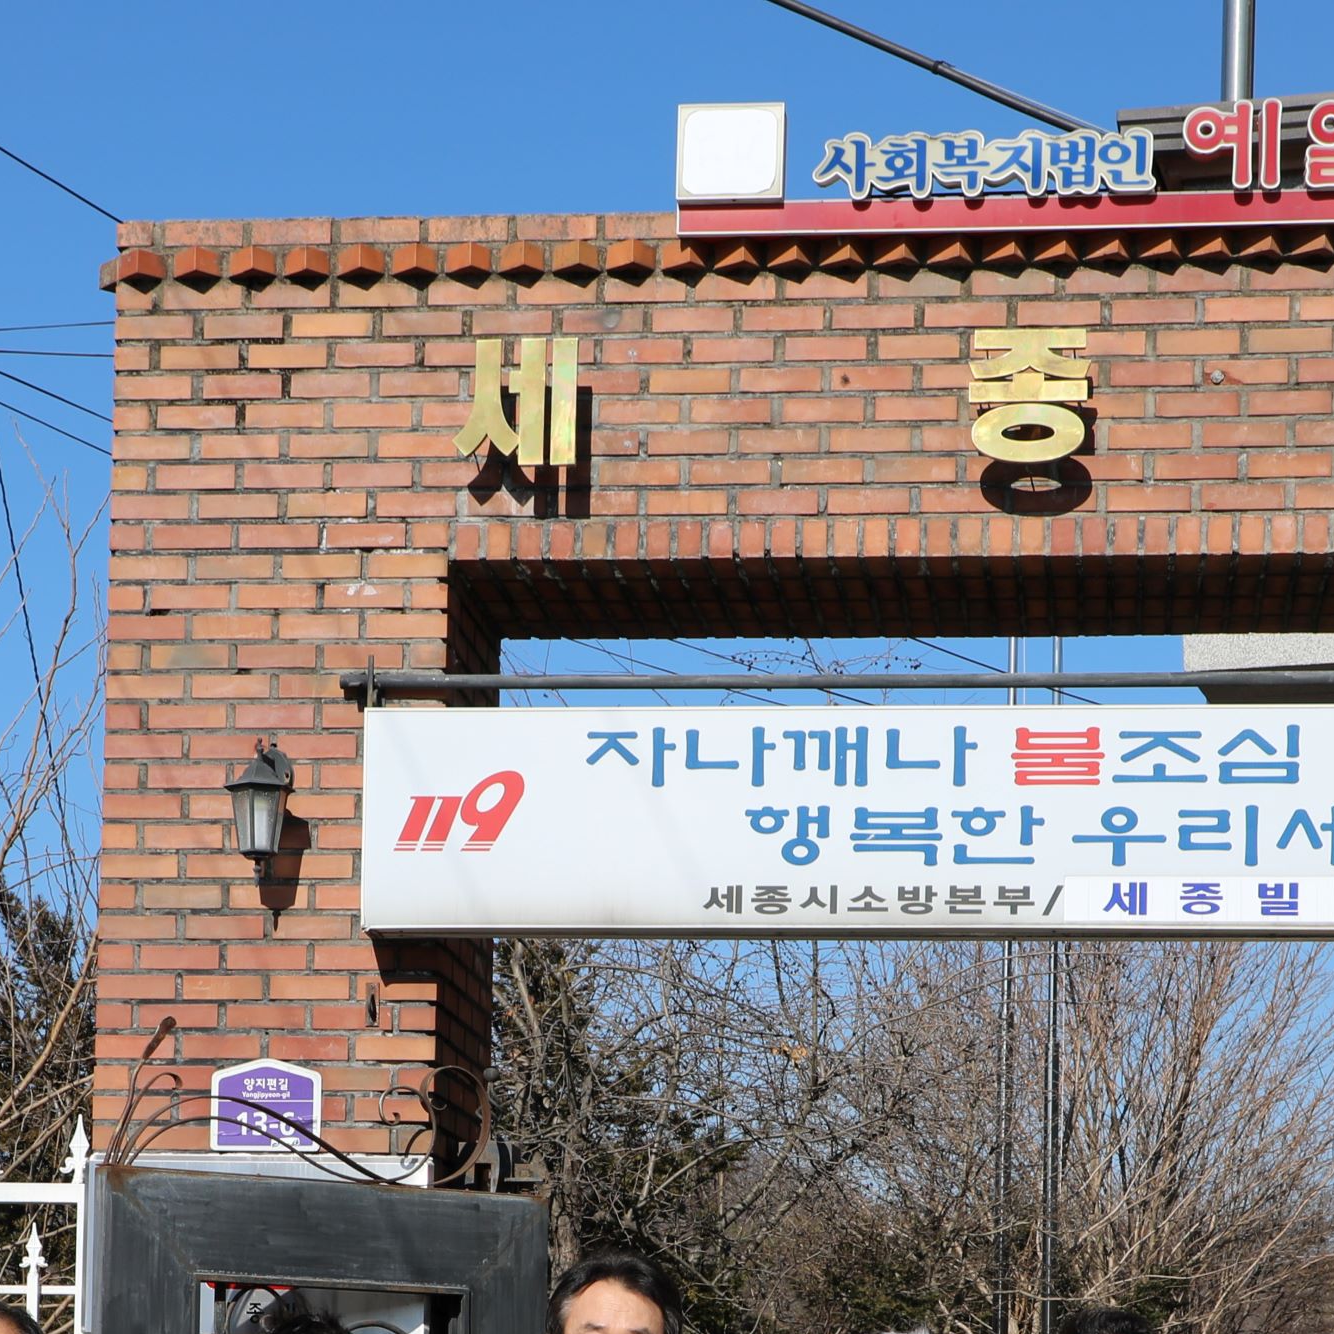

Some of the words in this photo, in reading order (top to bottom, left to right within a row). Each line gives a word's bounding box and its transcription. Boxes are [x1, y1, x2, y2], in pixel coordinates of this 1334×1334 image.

[814, 128, 1156, 199] 사회복지법인
[452, 338, 578, 466] 세
[967, 329, 1095, 462] 종
[586, 726, 978, 788] 자나깨나
[1011, 724, 1300, 786] 불조심
[394, 770, 525, 851] 119
[745, 805, 1045, 867] 행복한
[244, 1078, 289, 1091] 양지편길
[236, 1111, 295, 1136] 13-6
